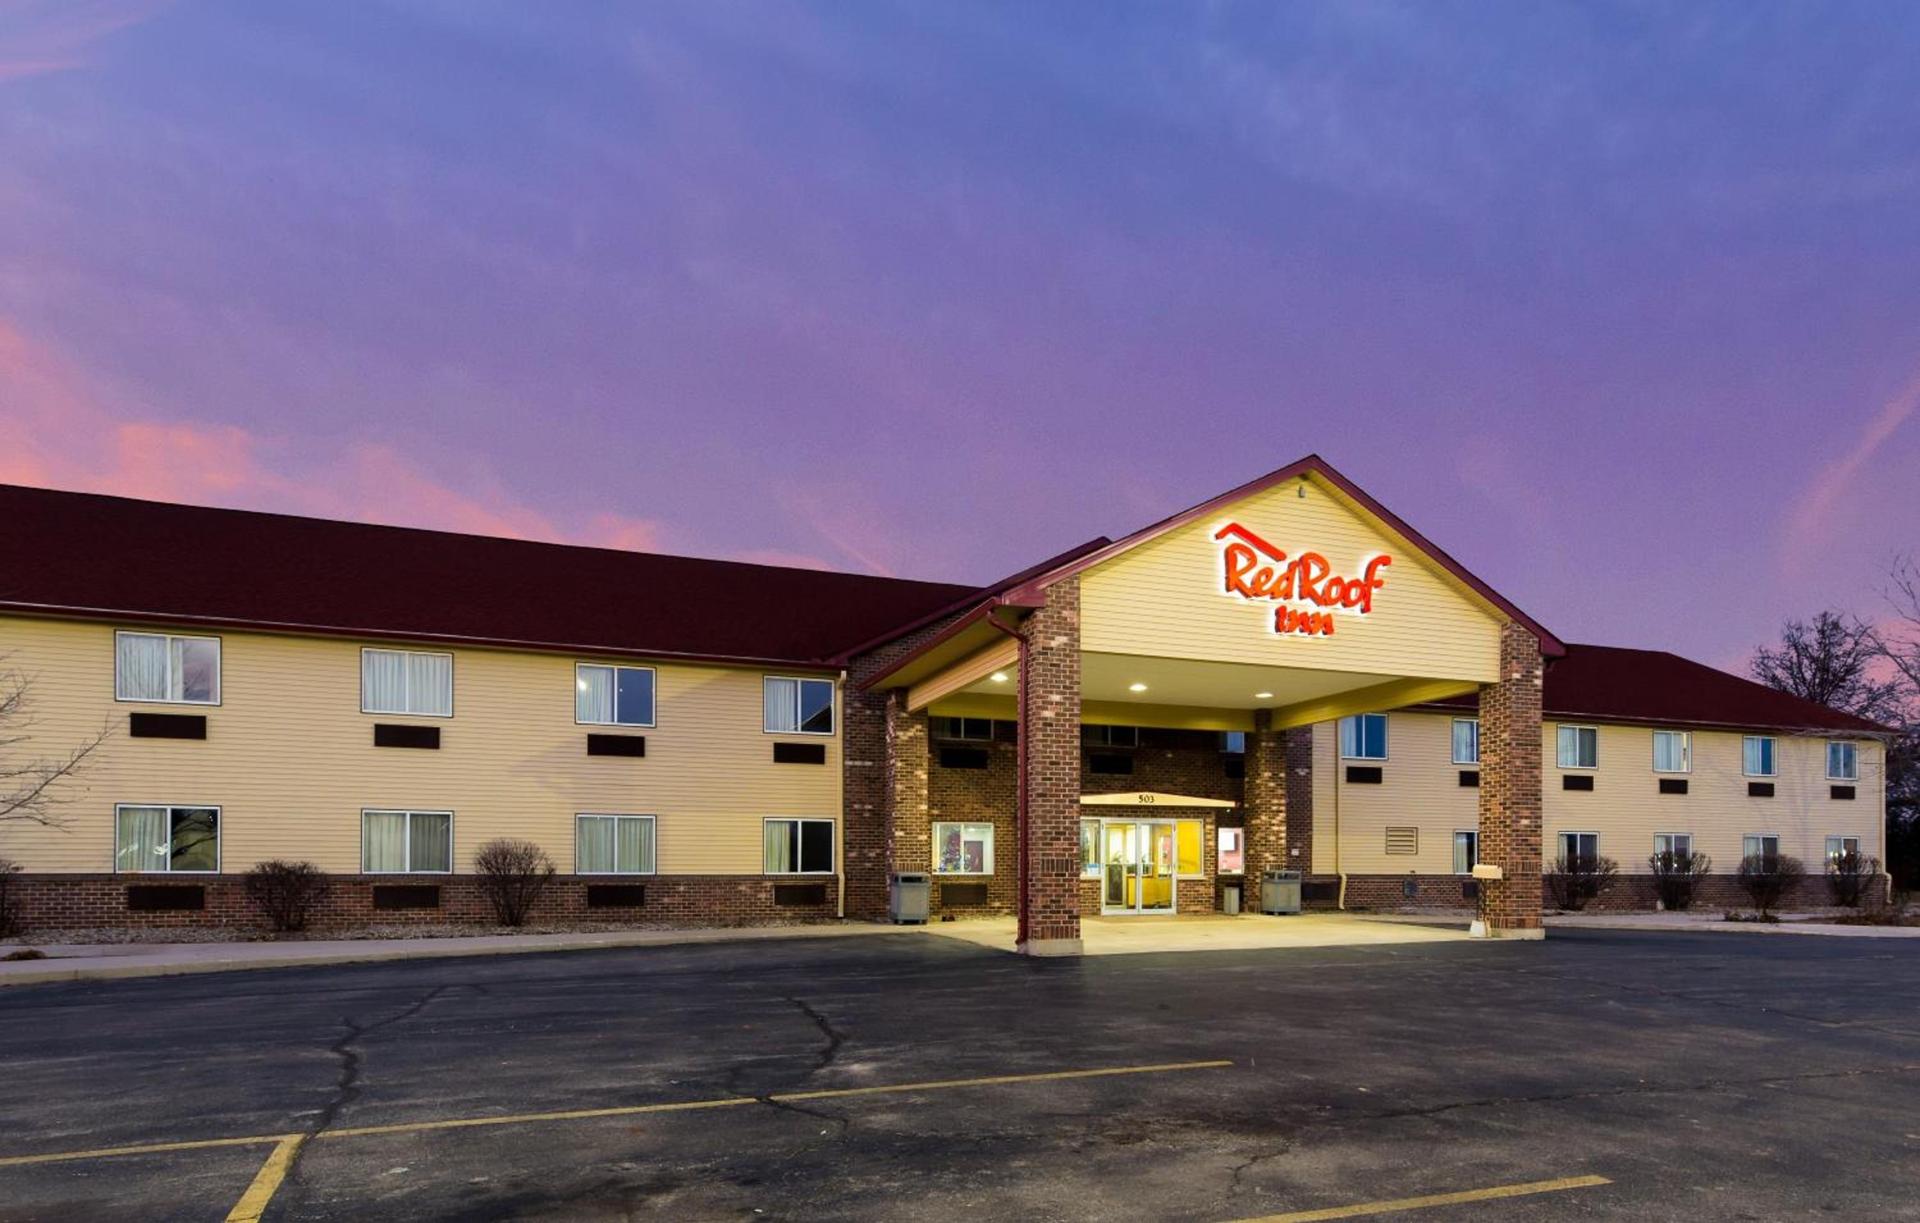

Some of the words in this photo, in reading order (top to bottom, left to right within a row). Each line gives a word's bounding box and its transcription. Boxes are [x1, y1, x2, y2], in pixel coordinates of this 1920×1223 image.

[1225, 543, 1299, 599] Red
[1299, 552, 1391, 613] Roof
[1138, 794, 1154, 803] 503
